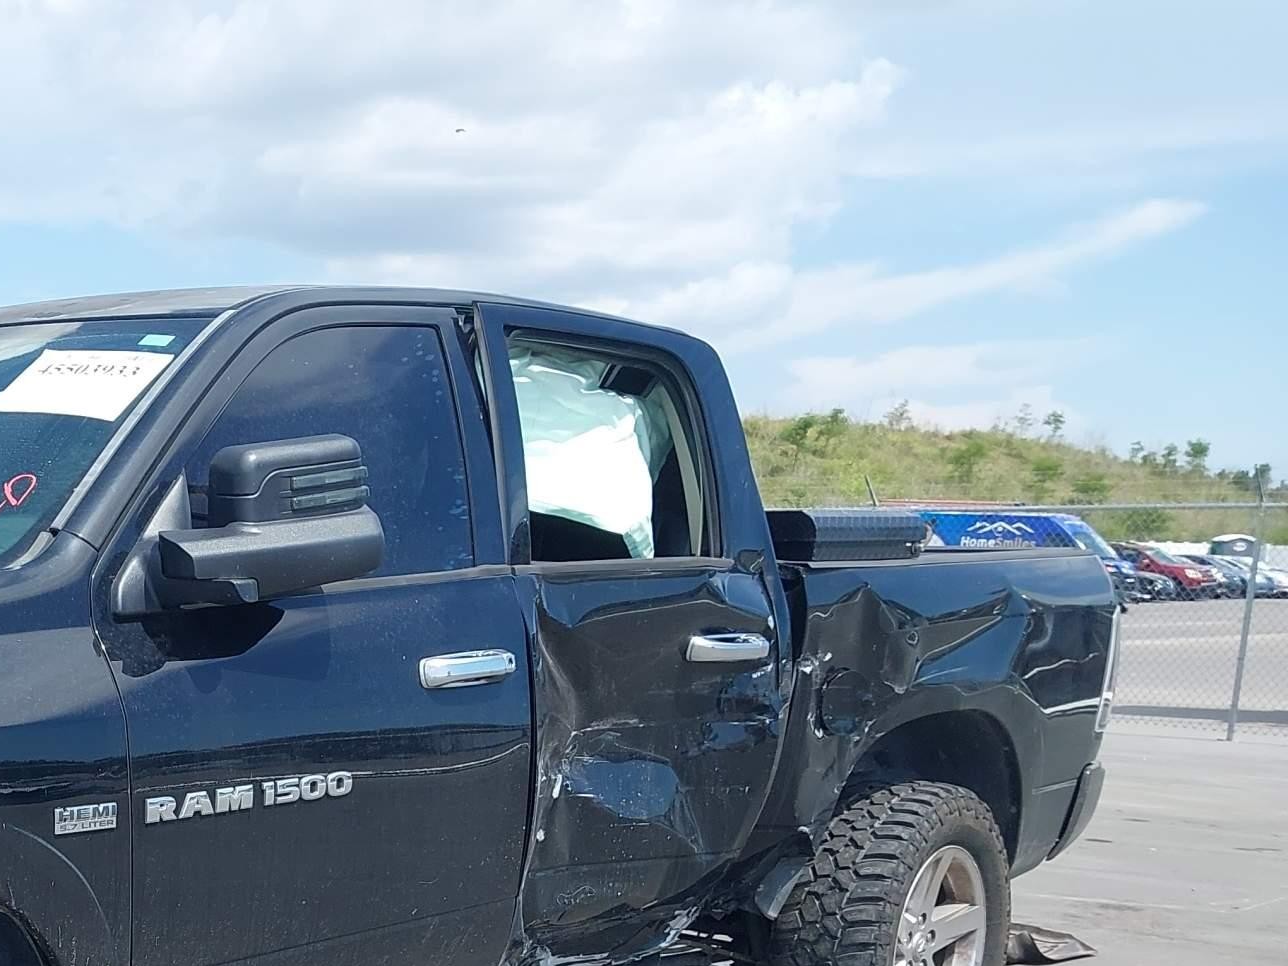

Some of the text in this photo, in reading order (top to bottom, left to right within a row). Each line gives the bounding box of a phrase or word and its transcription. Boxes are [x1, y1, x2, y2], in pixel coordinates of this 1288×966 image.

[960, 535, 1037, 549] HomeSmiles
[145, 770, 353, 825] RAM 1500
[57, 804, 117, 823] HEMI
[80, 818, 115, 830] LITER
